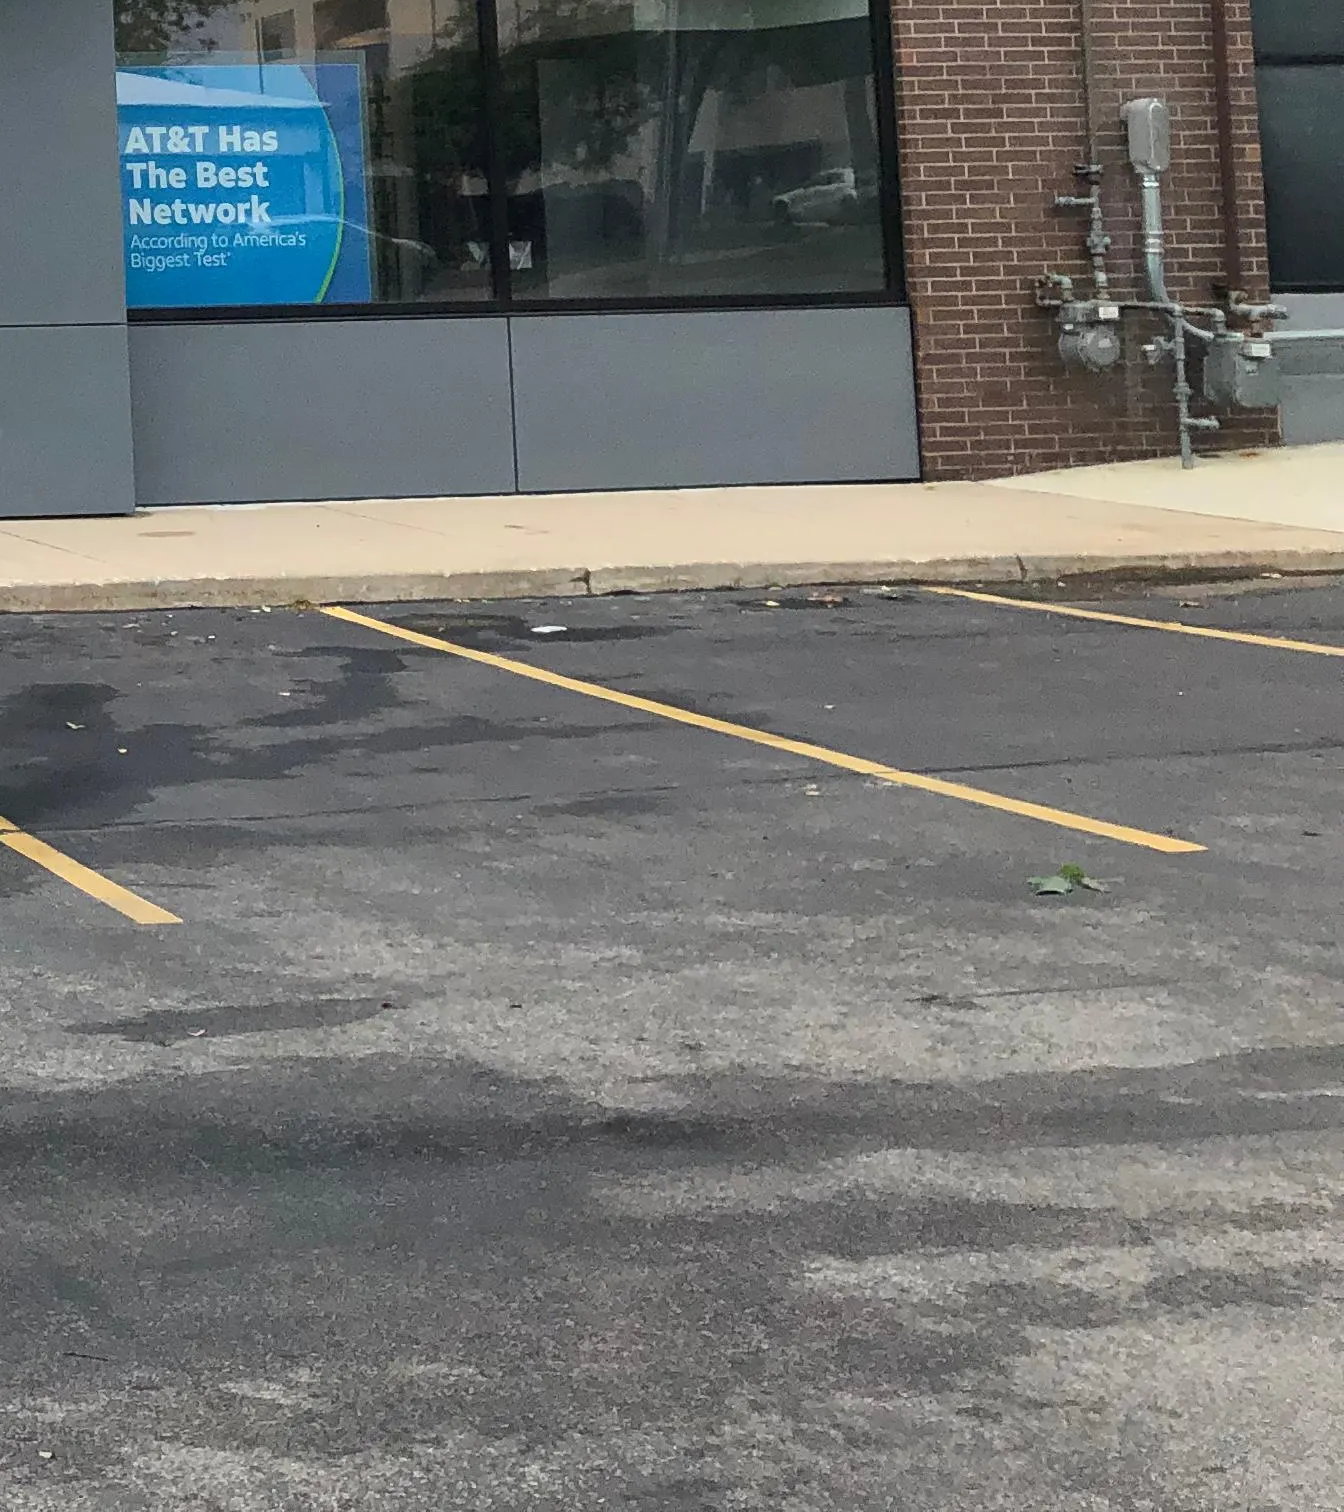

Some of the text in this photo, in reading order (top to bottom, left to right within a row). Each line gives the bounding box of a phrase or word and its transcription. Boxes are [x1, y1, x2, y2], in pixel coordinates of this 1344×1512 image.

[124, 125, 279, 153] AT&T Has
[125, 161, 270, 189] The Best
[128, 195, 272, 225] Network
[130, 231, 307, 253] According to America's
[130, 252, 191, 272] Biggest
